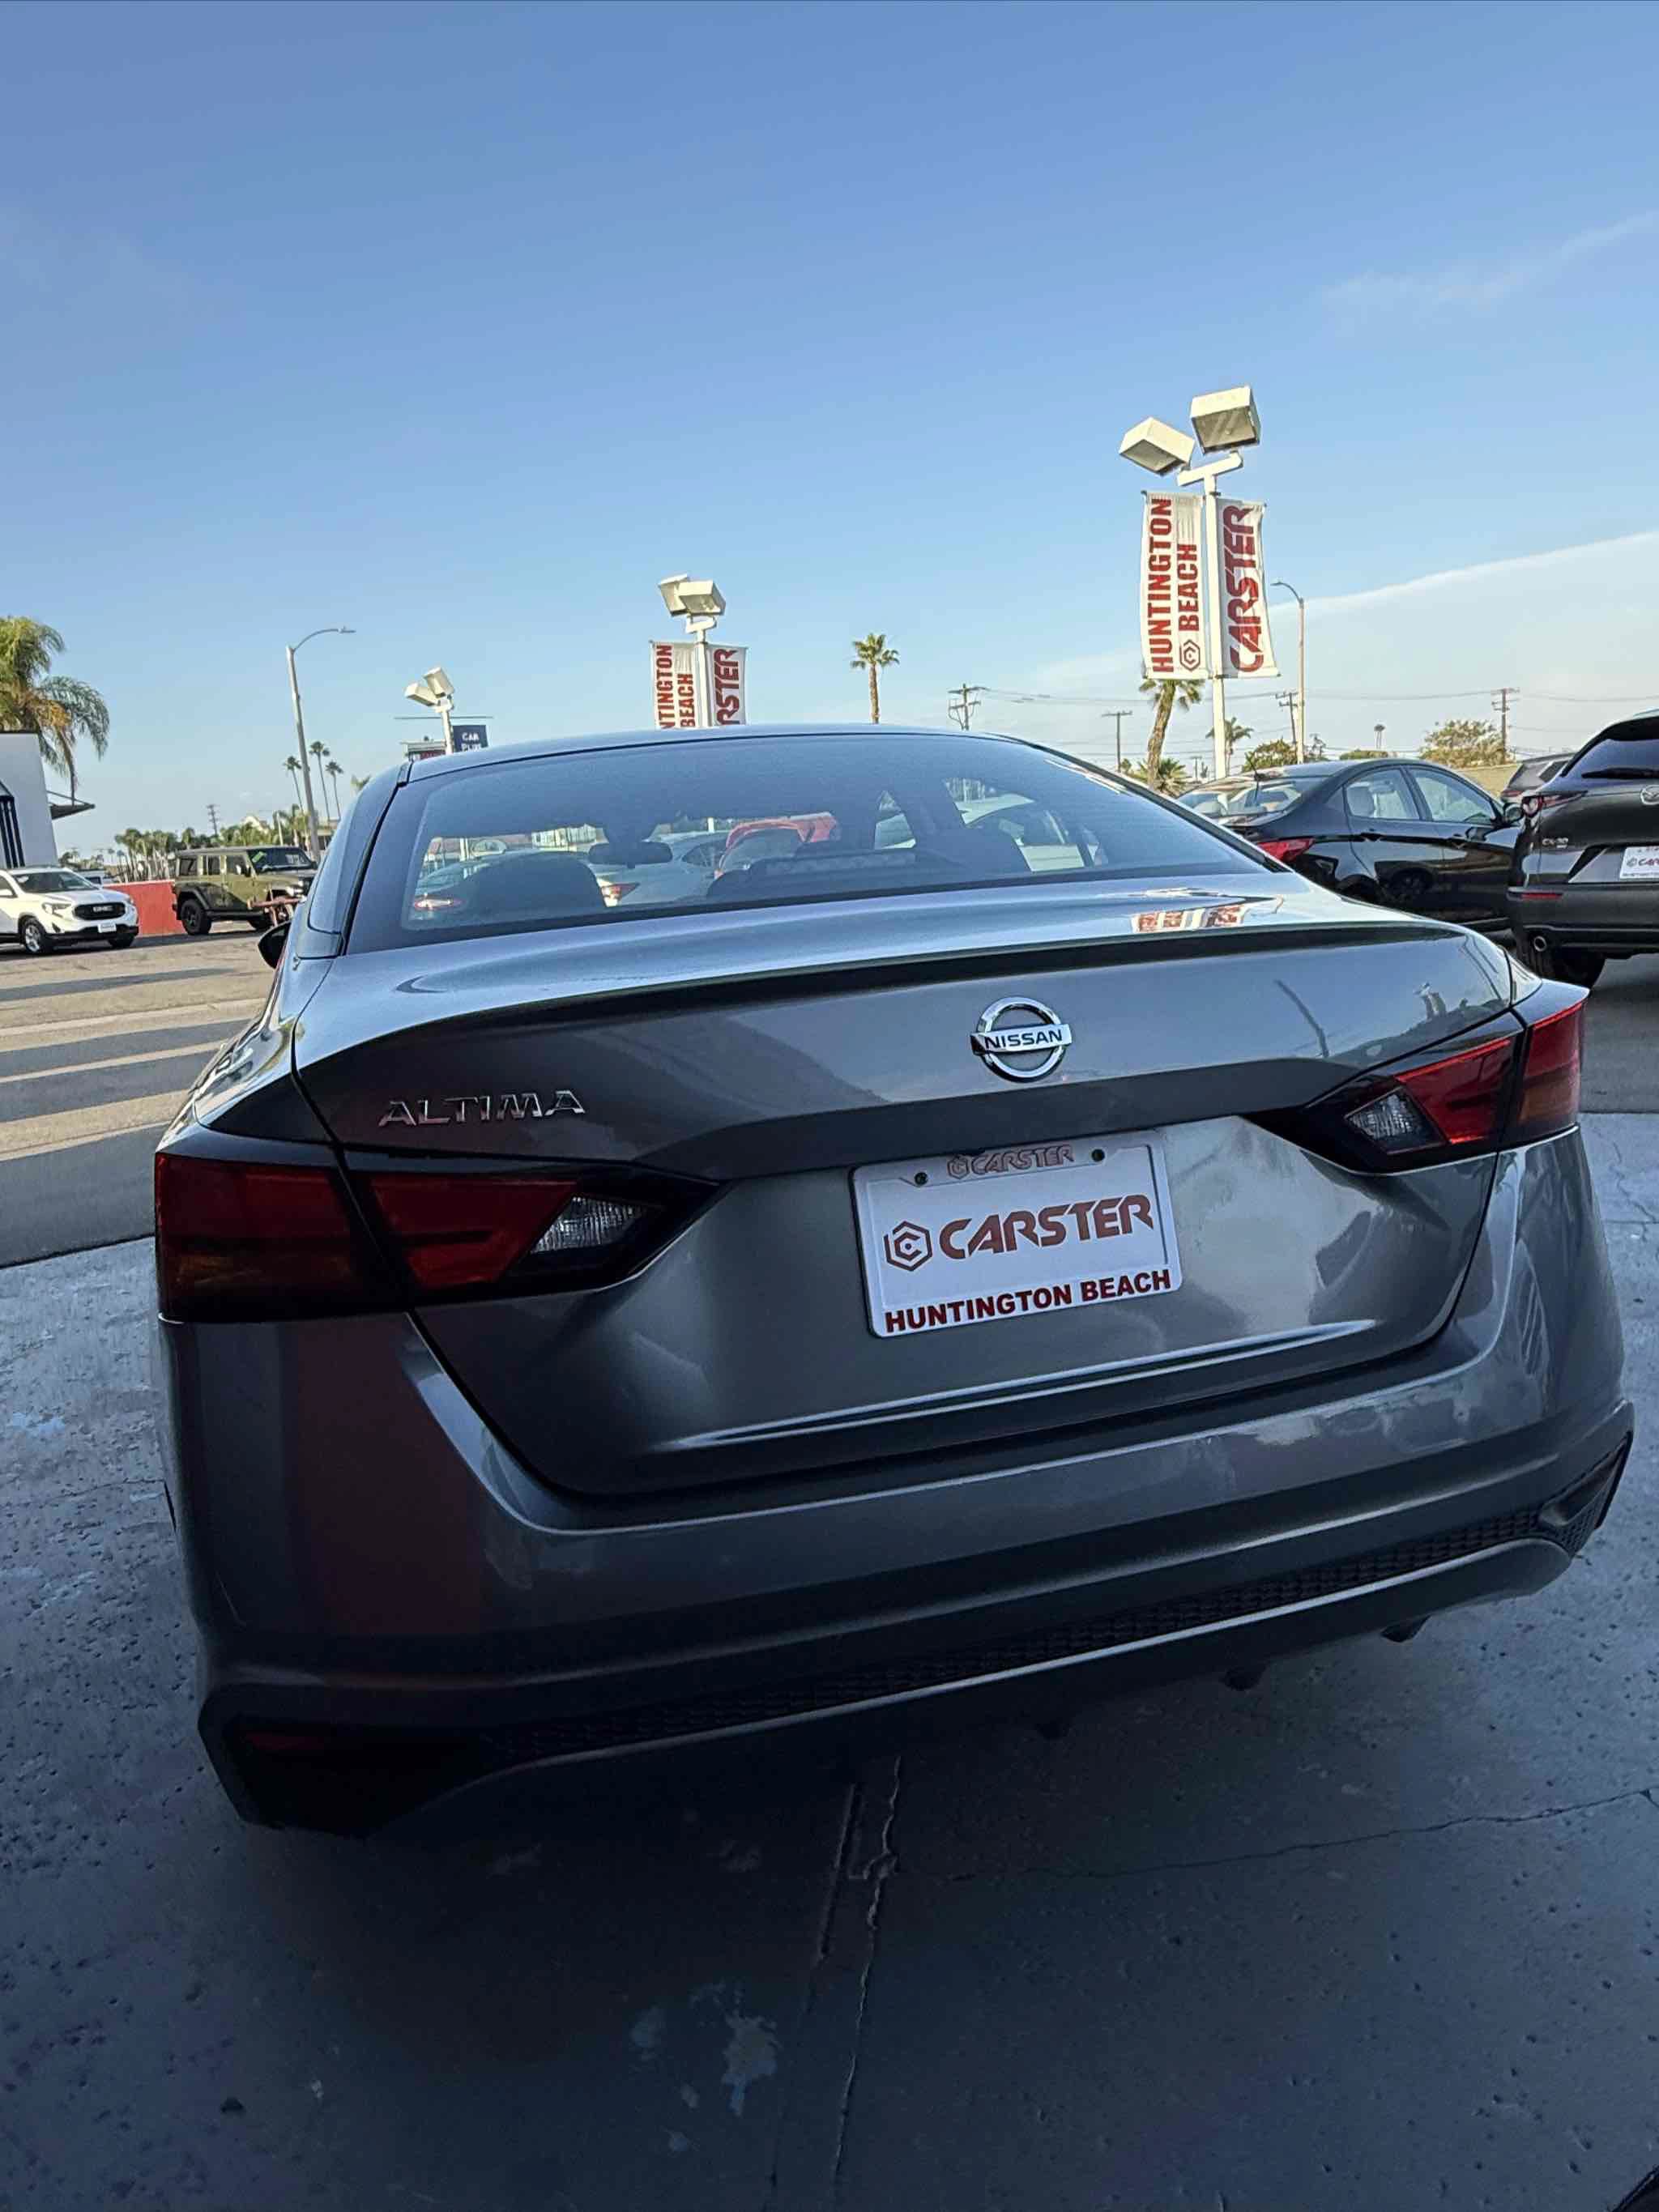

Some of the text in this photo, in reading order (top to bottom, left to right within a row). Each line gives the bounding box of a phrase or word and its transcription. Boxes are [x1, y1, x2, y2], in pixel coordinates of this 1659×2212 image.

[1147, 497, 1174, 673] HUNTINGTON
[1176, 543, 1201, 632] BEACH
[1222, 505, 1265, 673] CARSTER
[655, 644, 676, 729] NTINGTON
[677, 673, 696, 727] BEACH
[714, 648, 740, 726] RSTER
[984, 1027, 1063, 1049] NISSAN
[377, 1089, 586, 1127] ALTIMA
[971, 1144, 1075, 1174] CARSTER
[939, 1194, 1154, 1259] CARSTER
[885, 1268, 1171, 1333] HUNTINGTON BEACH
